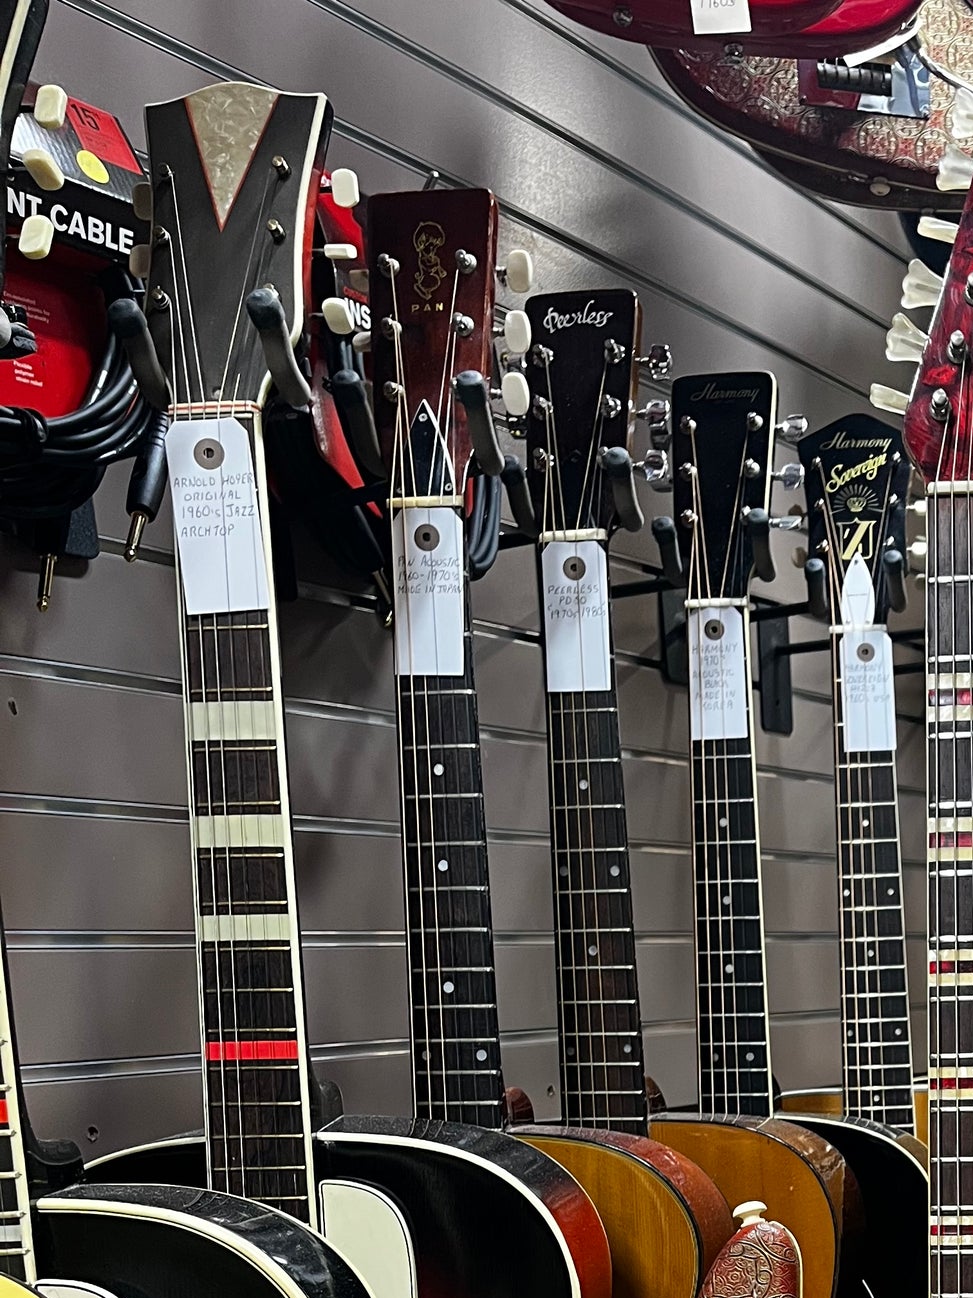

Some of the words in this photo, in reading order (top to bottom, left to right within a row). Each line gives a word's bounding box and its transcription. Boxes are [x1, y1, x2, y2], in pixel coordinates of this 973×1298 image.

[50, 203, 135, 255] CABLE
[411, 302, 444, 313] PAN
[543, 300, 614, 334] Peerless
[690, 382, 761, 401] Harmony
[819, 432, 893, 452] Harmony
[825, 452, 888, 493] Sovereign
[174, 476, 216, 488] ARNOLD
[184, 490, 241, 501] ORIGINAL
[226, 504, 255, 517] JAZZ
[547, 584, 600, 595] PEERLESS
[692, 668, 734, 679] AOUSTIC
